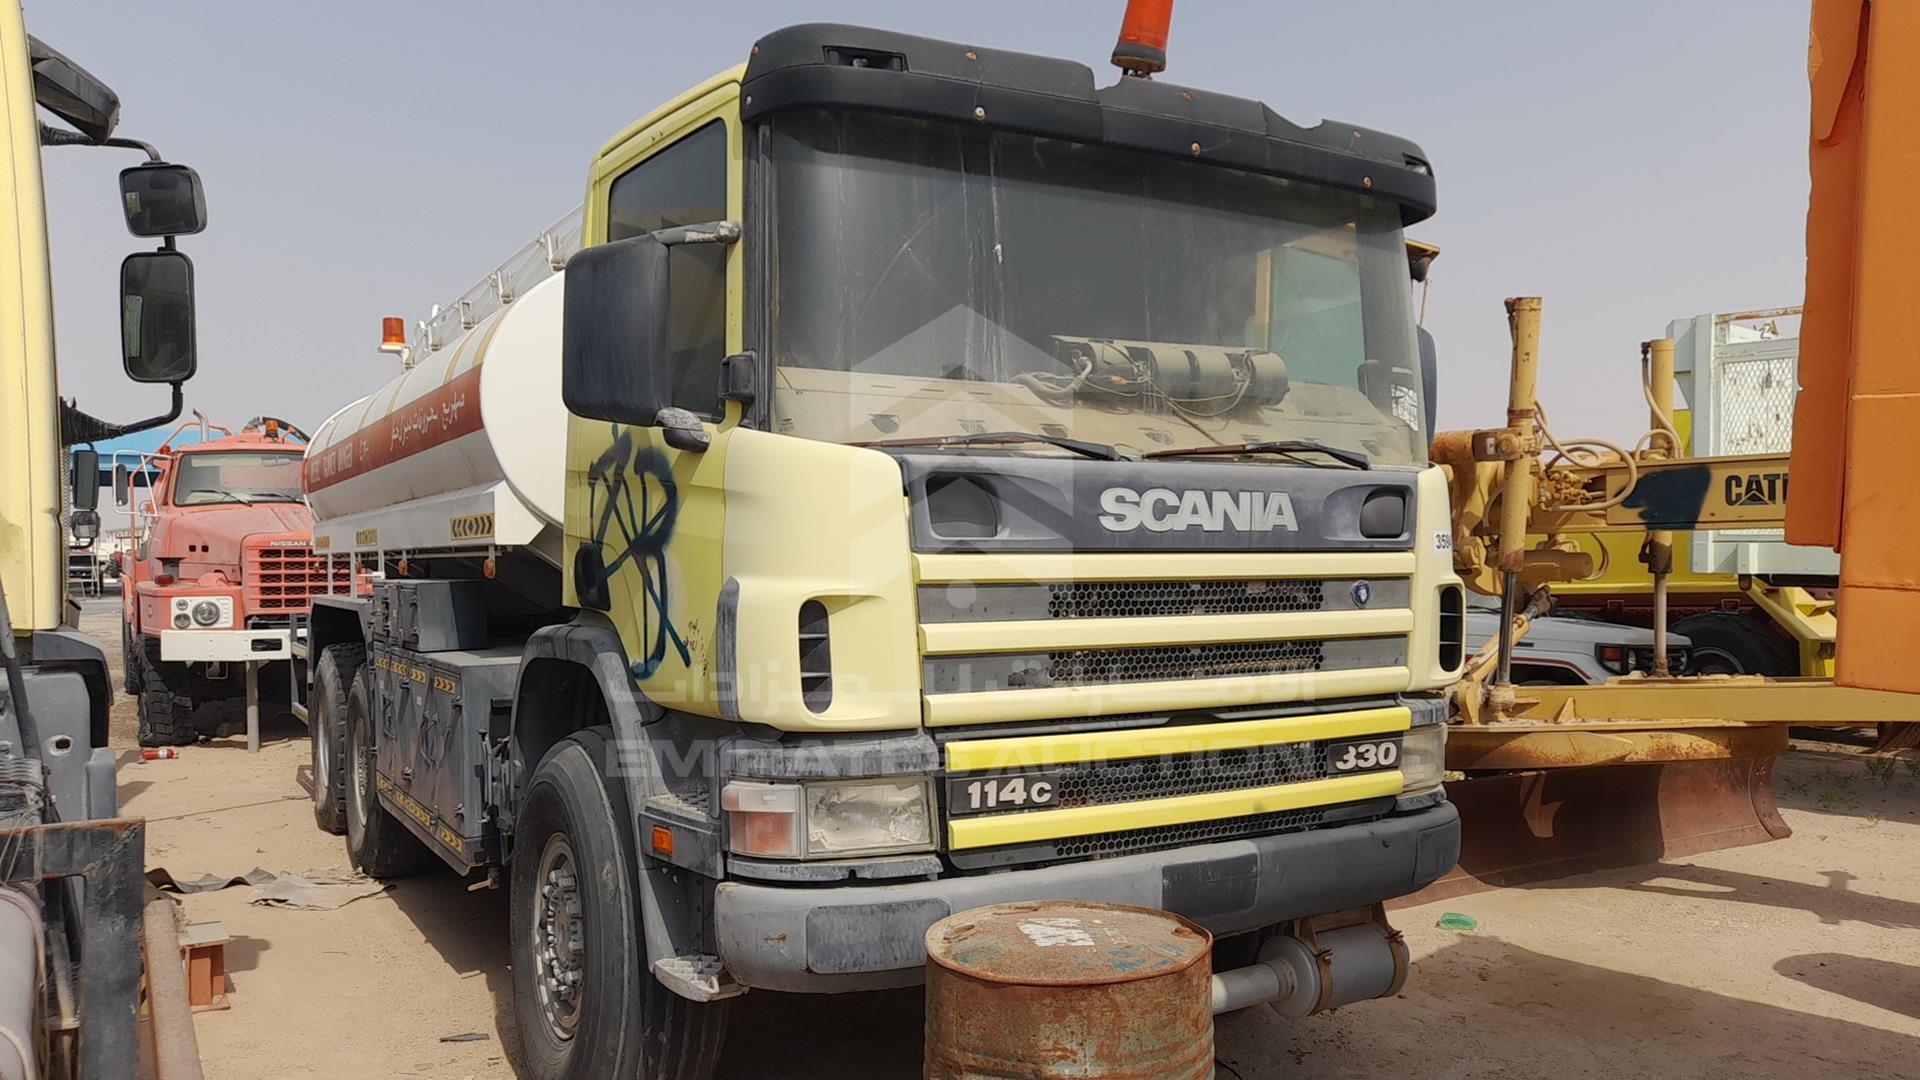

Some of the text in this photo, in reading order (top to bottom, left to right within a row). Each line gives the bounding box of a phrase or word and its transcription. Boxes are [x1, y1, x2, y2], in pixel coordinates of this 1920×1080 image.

[1099, 487, 1299, 533] SCANIA
[271, 540, 306, 548] NISSAN
[1335, 742, 1397, 770] 330
